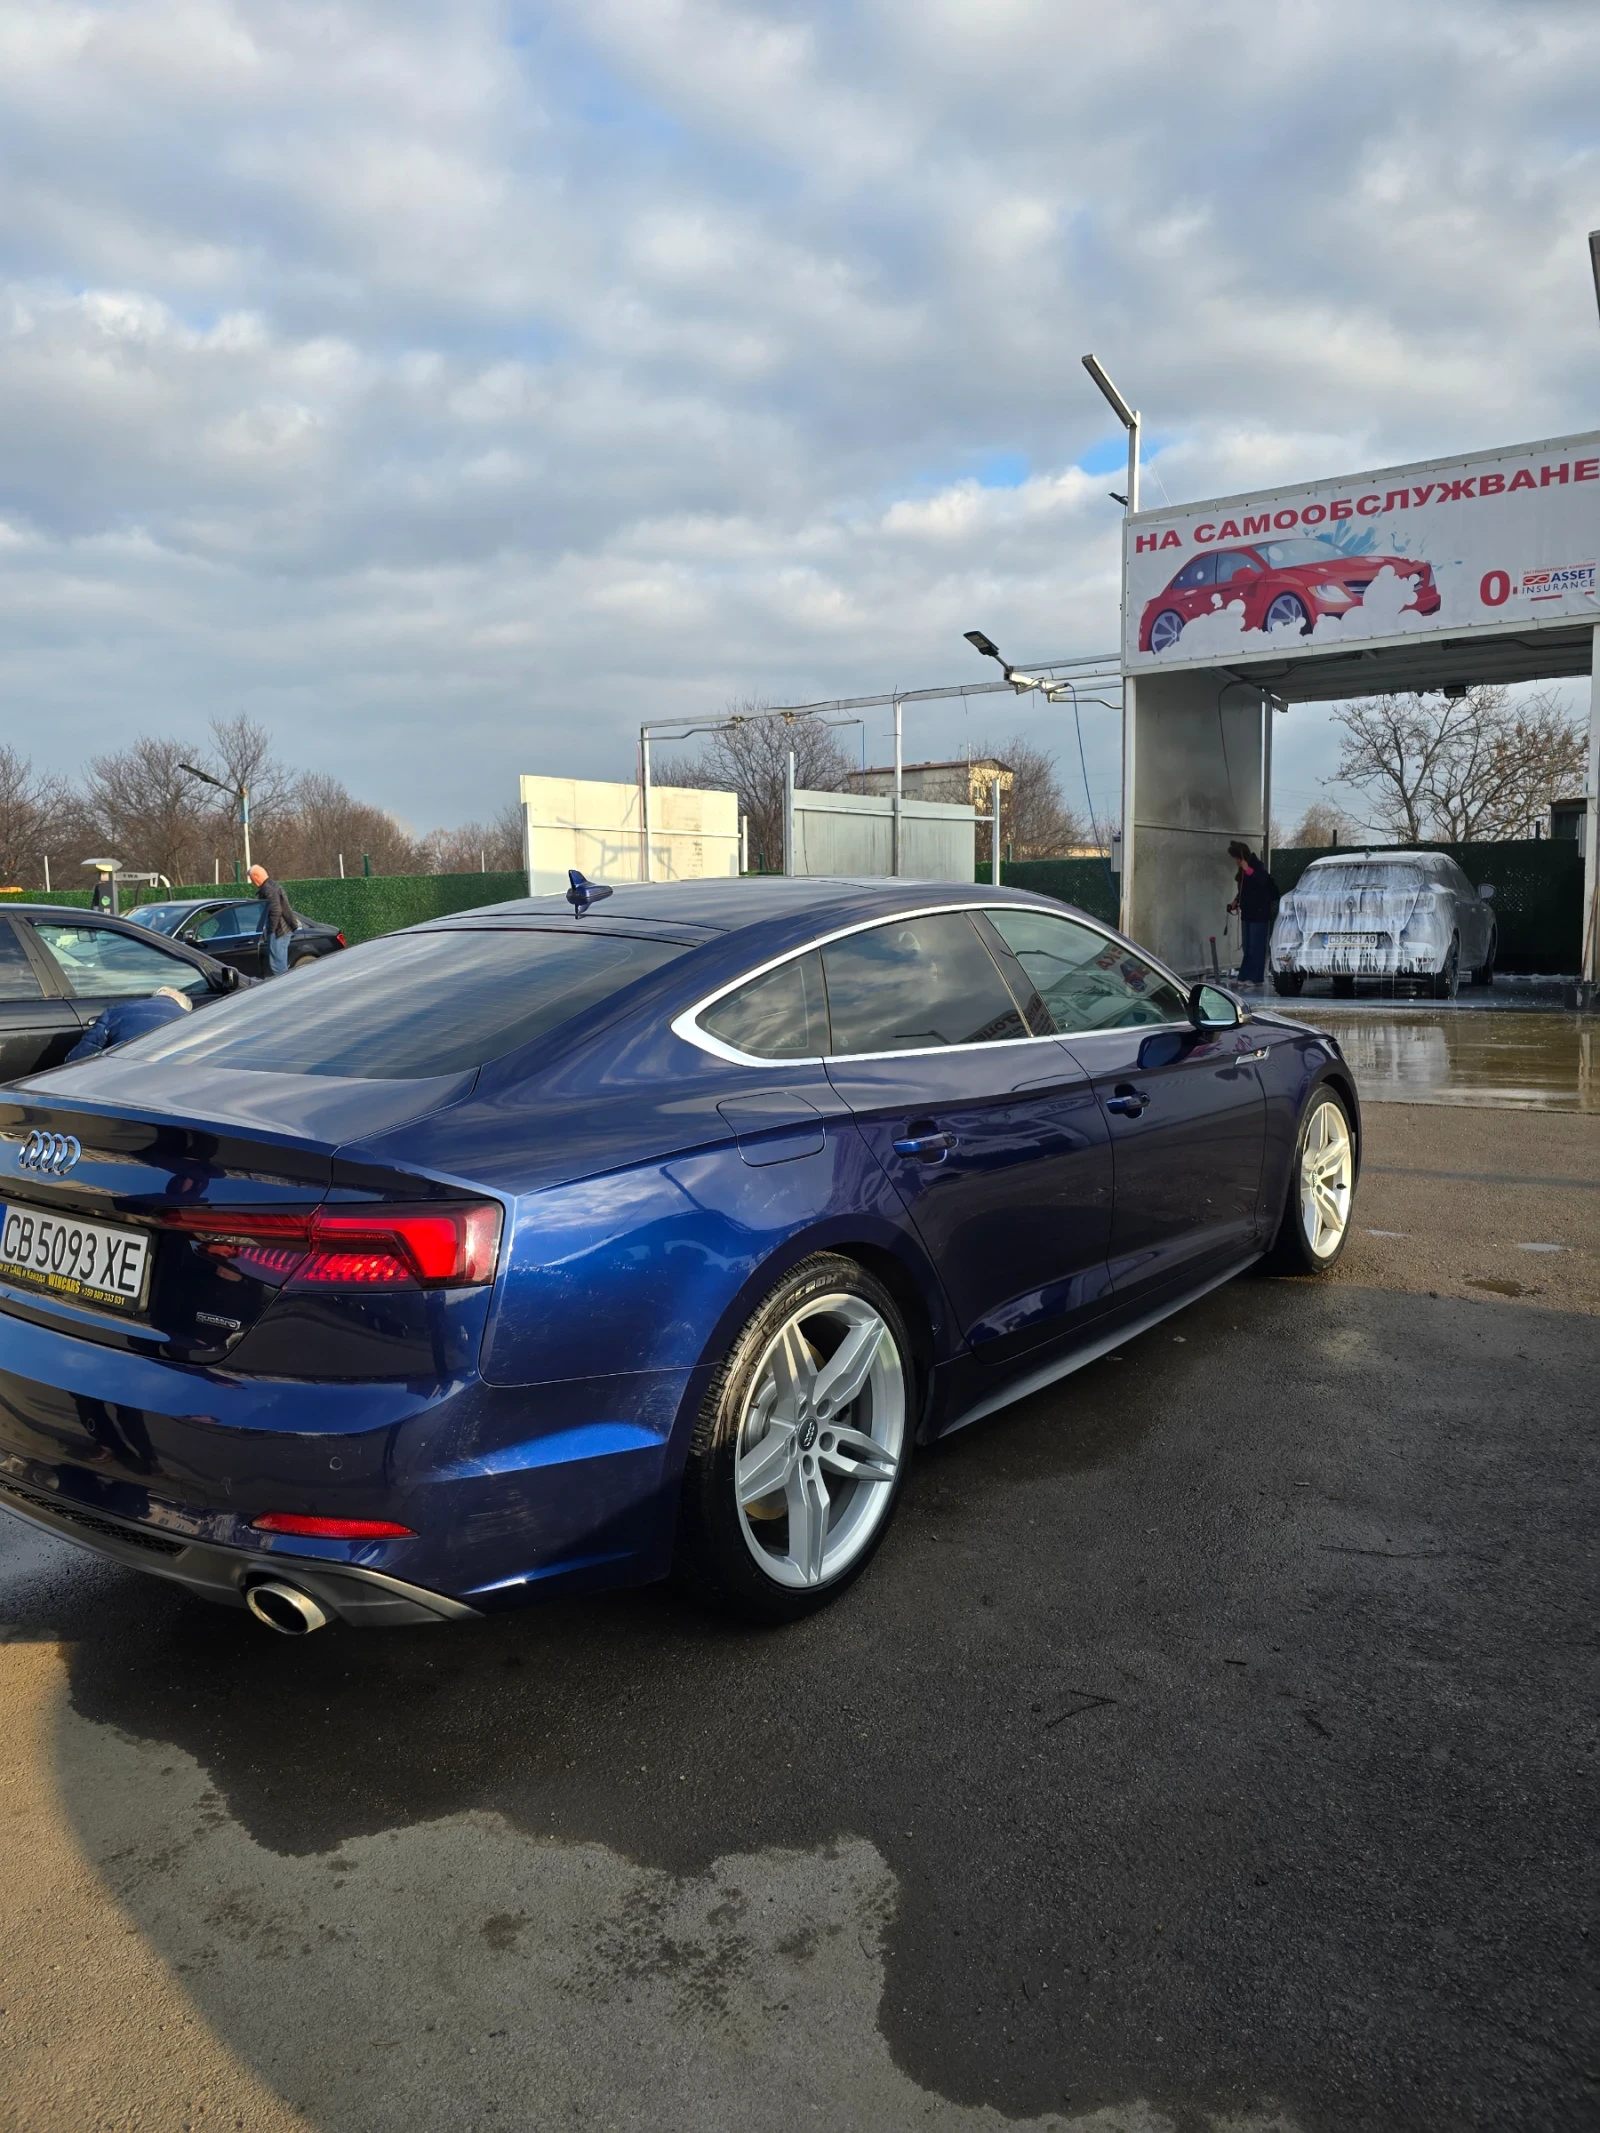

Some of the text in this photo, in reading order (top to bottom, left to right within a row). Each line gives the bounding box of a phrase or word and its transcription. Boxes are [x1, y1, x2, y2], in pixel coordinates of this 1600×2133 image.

[1135, 458, 1600, 554] НА САМООБСЛУЖВАНЕ
[1551, 568, 1596, 583] ASSET
[1522, 579, 1596, 595] INSURANCE
[35, 1221, 98, 1280] 5093
[48, 1273, 81, 1294] WINCARS
